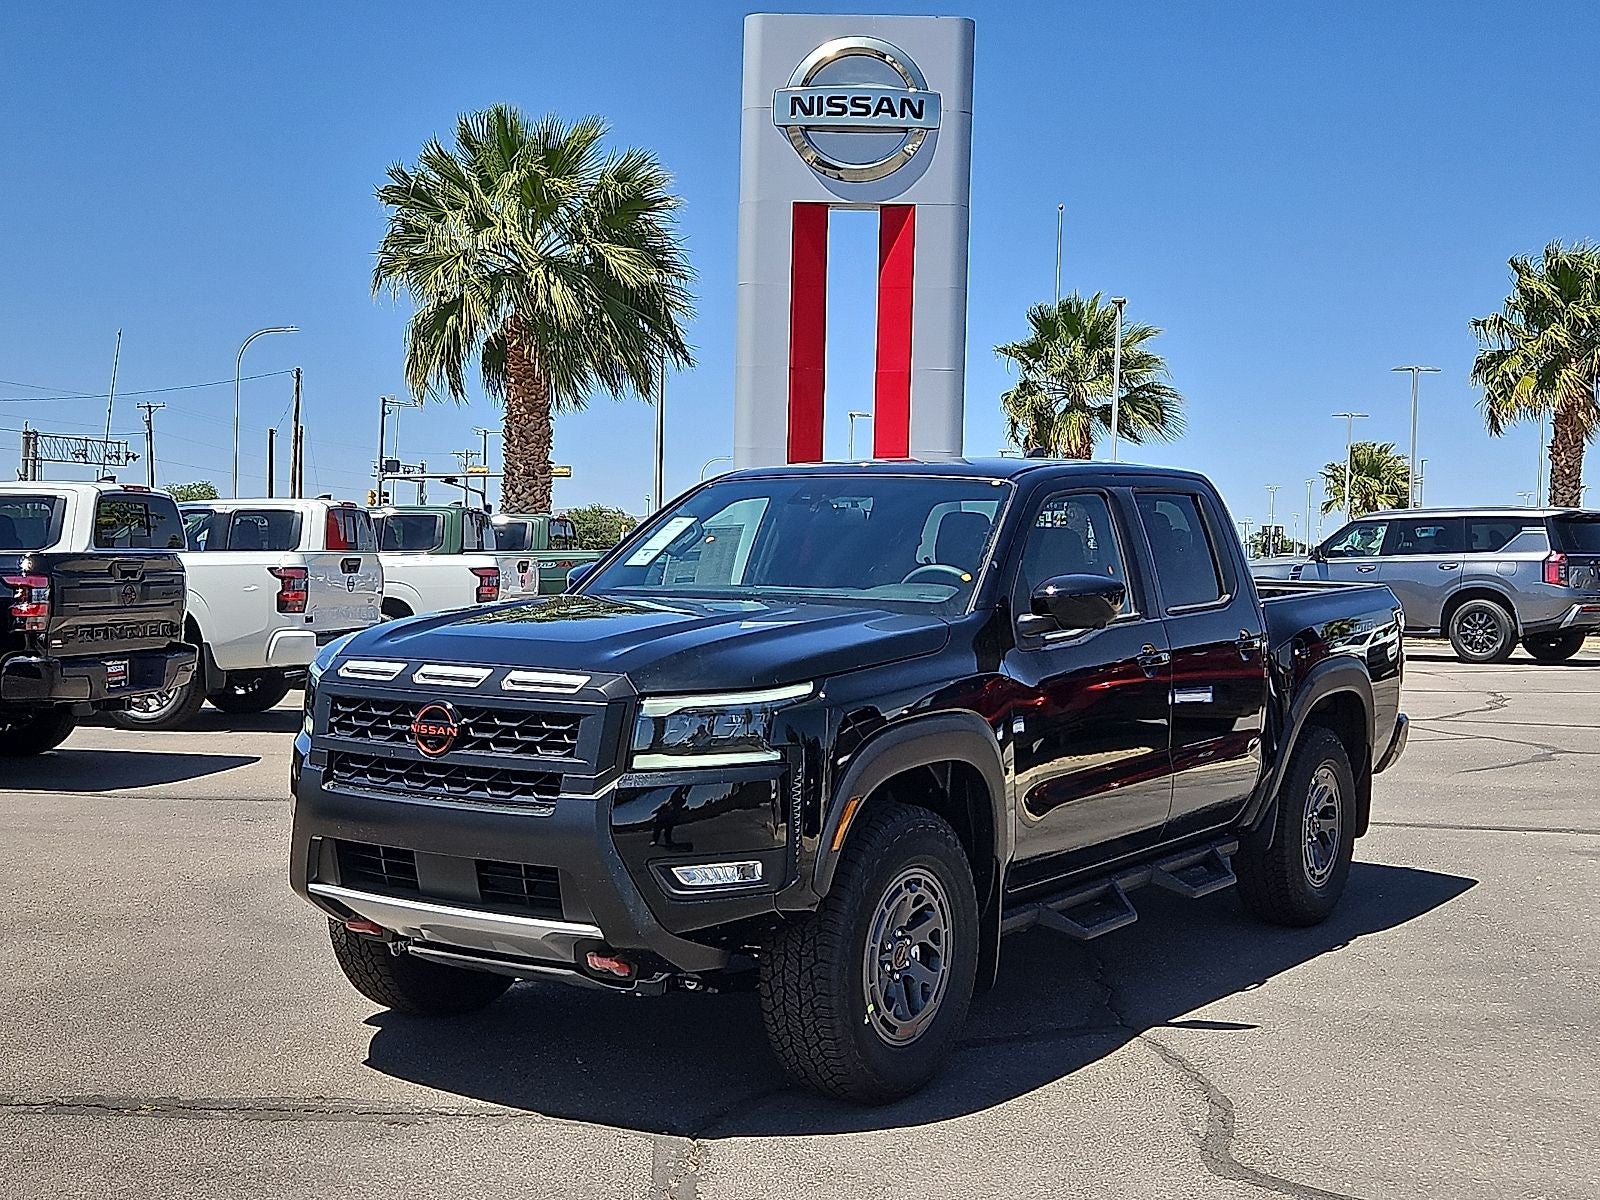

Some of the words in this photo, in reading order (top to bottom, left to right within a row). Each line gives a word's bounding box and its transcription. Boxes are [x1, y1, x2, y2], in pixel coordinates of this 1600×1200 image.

[790, 95, 925, 120] NISSAN
[62, 621, 172, 643] FRONTIER
[410, 723, 458, 736] NISSAN
